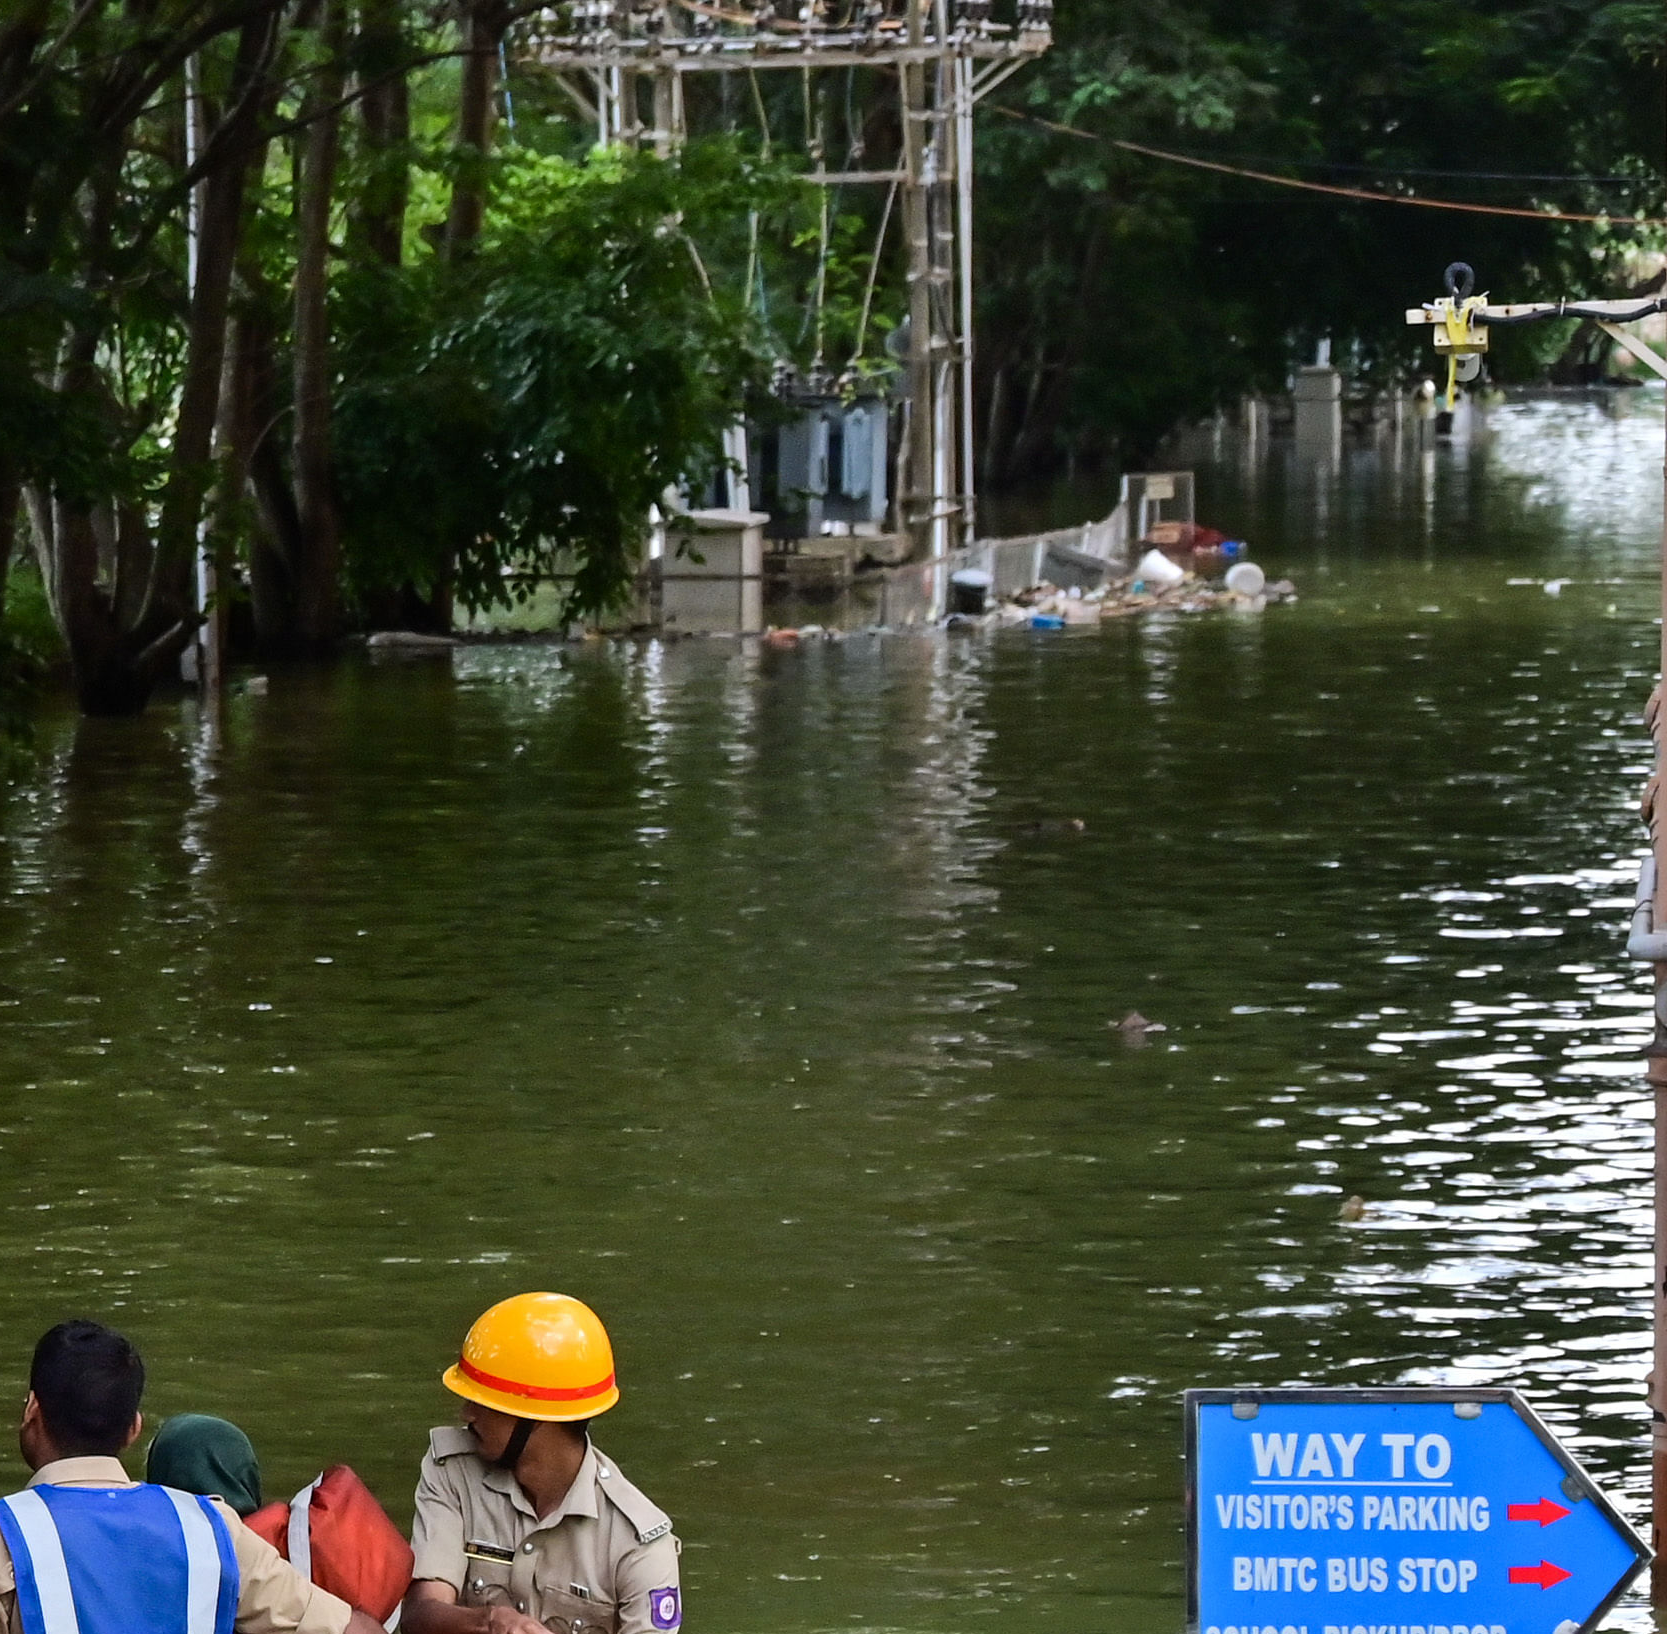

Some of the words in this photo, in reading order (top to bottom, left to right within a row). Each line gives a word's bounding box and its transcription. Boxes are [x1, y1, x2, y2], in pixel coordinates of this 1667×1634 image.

[1251, 1432, 1366, 1478] WAY
[1381, 1433, 1452, 1480] TO
[1216, 1494, 1355, 1531] VISITOR'S
[1363, 1496, 1490, 1532] PARKING
[1233, 1557, 1317, 1593] BMTC
[1327, 1557, 1389, 1593] BUS
[1398, 1557, 1477, 1593] STOP
